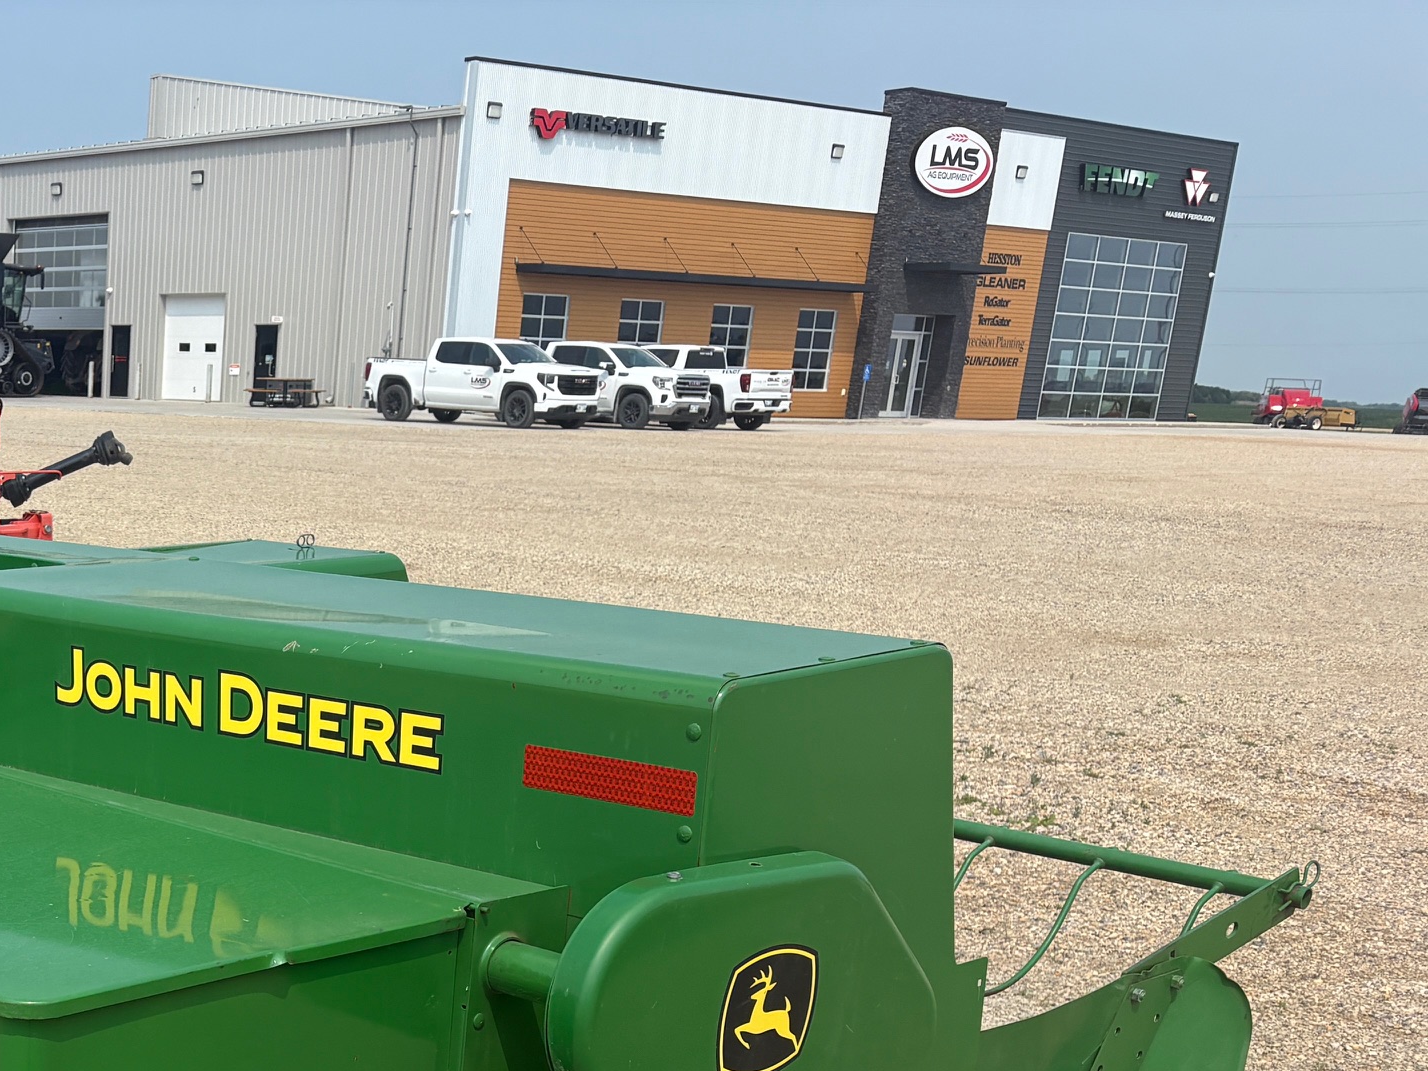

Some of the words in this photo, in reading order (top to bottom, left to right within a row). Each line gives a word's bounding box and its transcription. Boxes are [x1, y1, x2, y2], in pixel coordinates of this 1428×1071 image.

[566, 111, 667, 139] VERSATILE
[930, 144, 980, 171] LMS
[927, 171, 937, 179] AG
[937, 171, 973, 181] EQUIPMENT
[1082, 162, 1160, 197] FENDT
[1165, 210, 1188, 220] MASSEY
[1188, 212, 1216, 223] FERGUSON
[987, 252, 1022, 266] HESSTON
[976, 275, 1026, 290] GLEANER
[977, 314, 1012, 327] TerraGator
[968, 335, 994, 348] recision
[996, 336, 1025, 352] Planting
[964, 355, 1019, 367] SUNFLOWER
[54, 645, 205, 732] JOHN
[216, 668, 445, 775] DEERE
